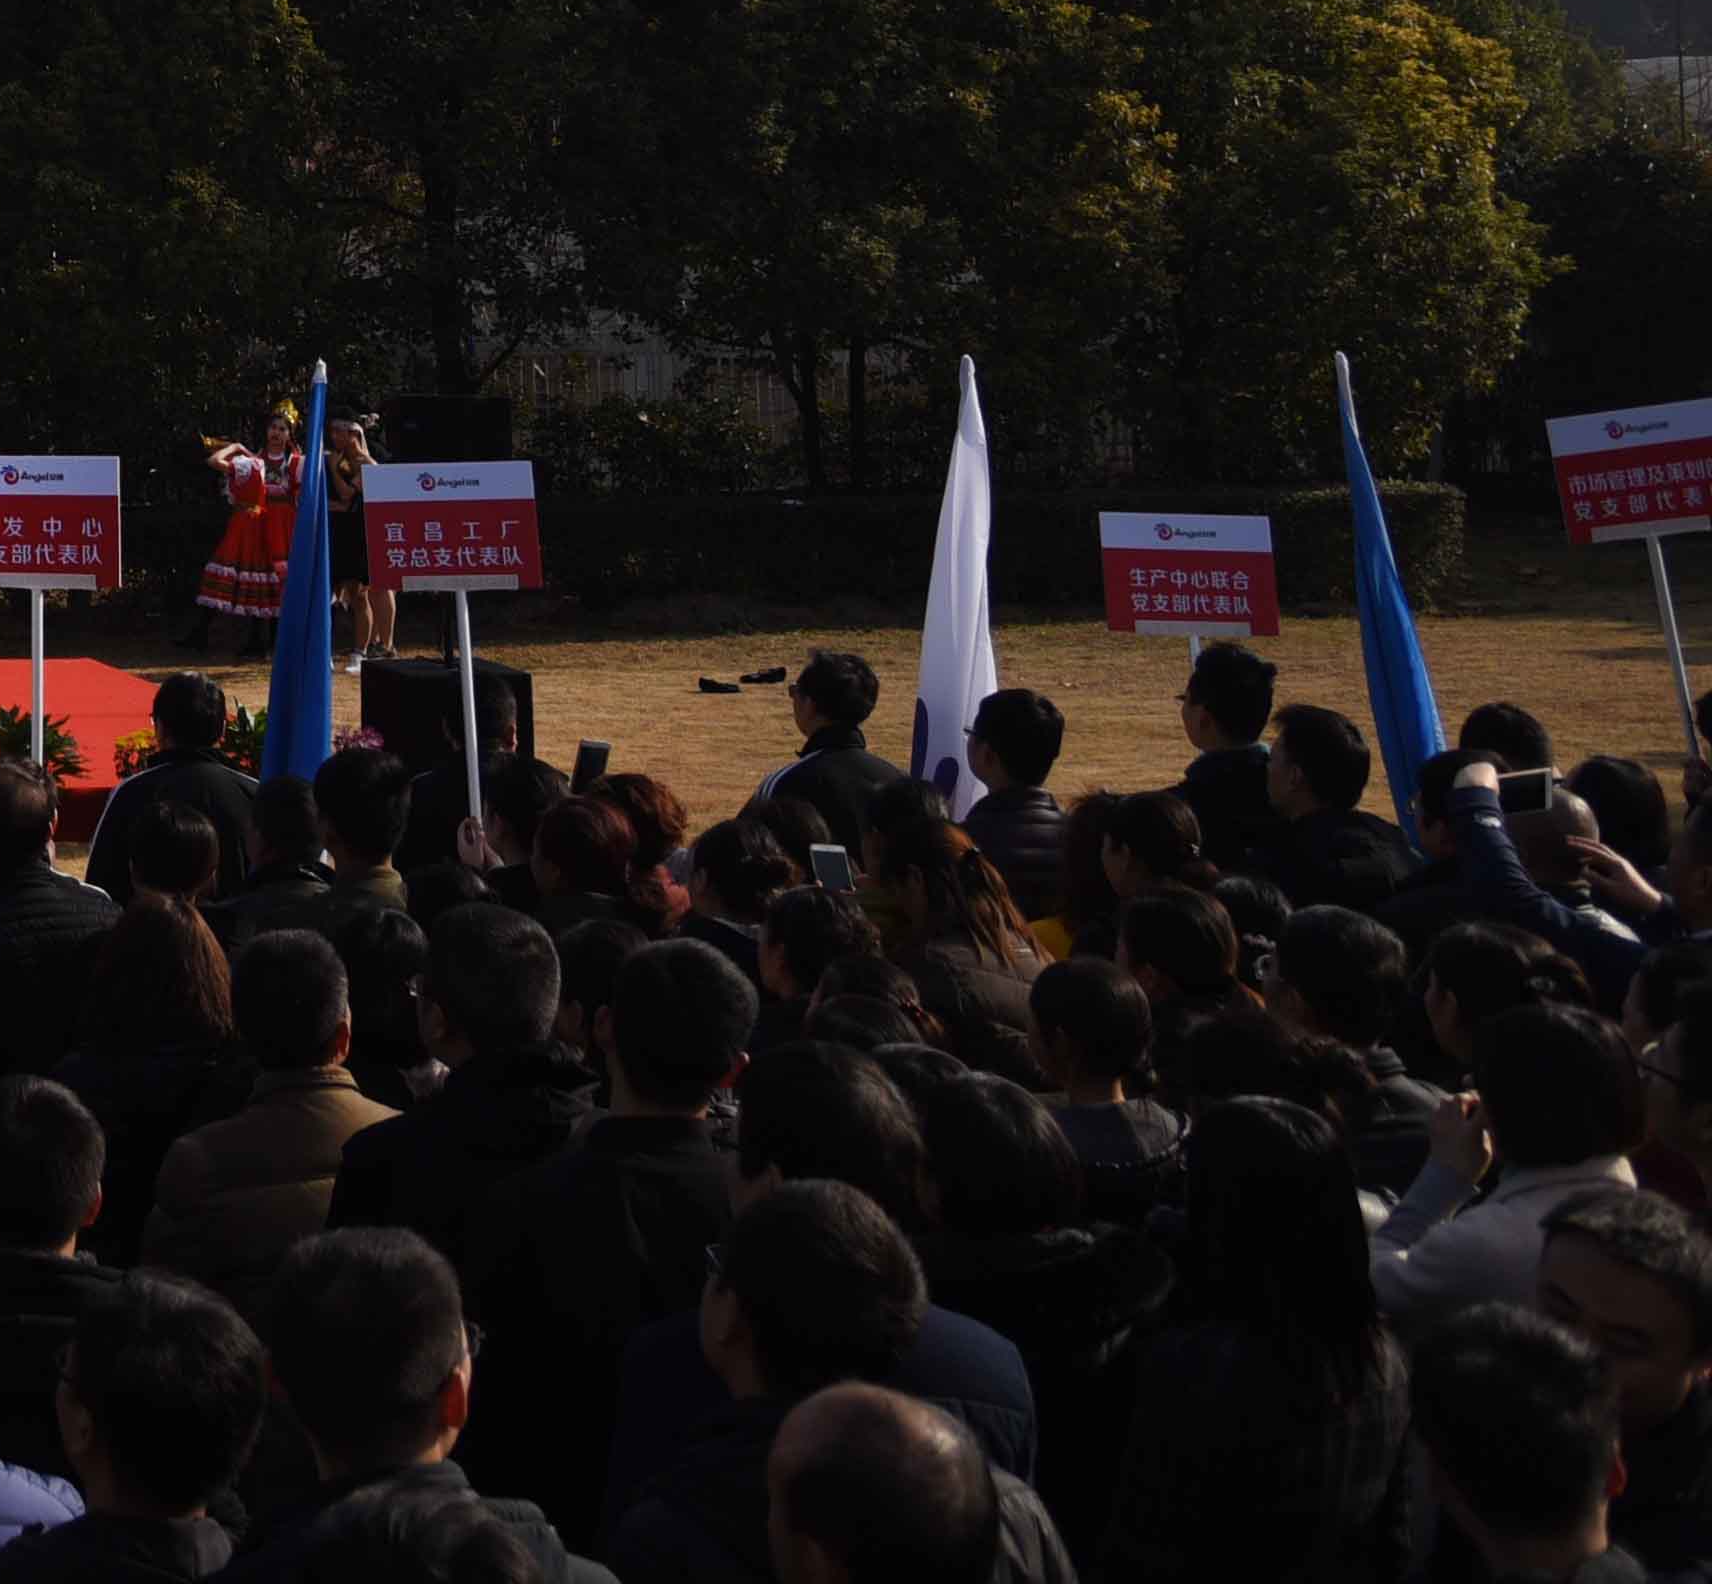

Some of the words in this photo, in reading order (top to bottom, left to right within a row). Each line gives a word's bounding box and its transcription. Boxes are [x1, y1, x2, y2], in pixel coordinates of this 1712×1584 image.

[1573, 486, 1712, 521] 党支部代表
[384, 520, 520, 542] 宜昌工厂
[386, 545, 524, 569] 党总支代表队
[1128, 567, 1250, 591] 生产中心联合
[1130, 591, 1253, 615] 党支部代表队
